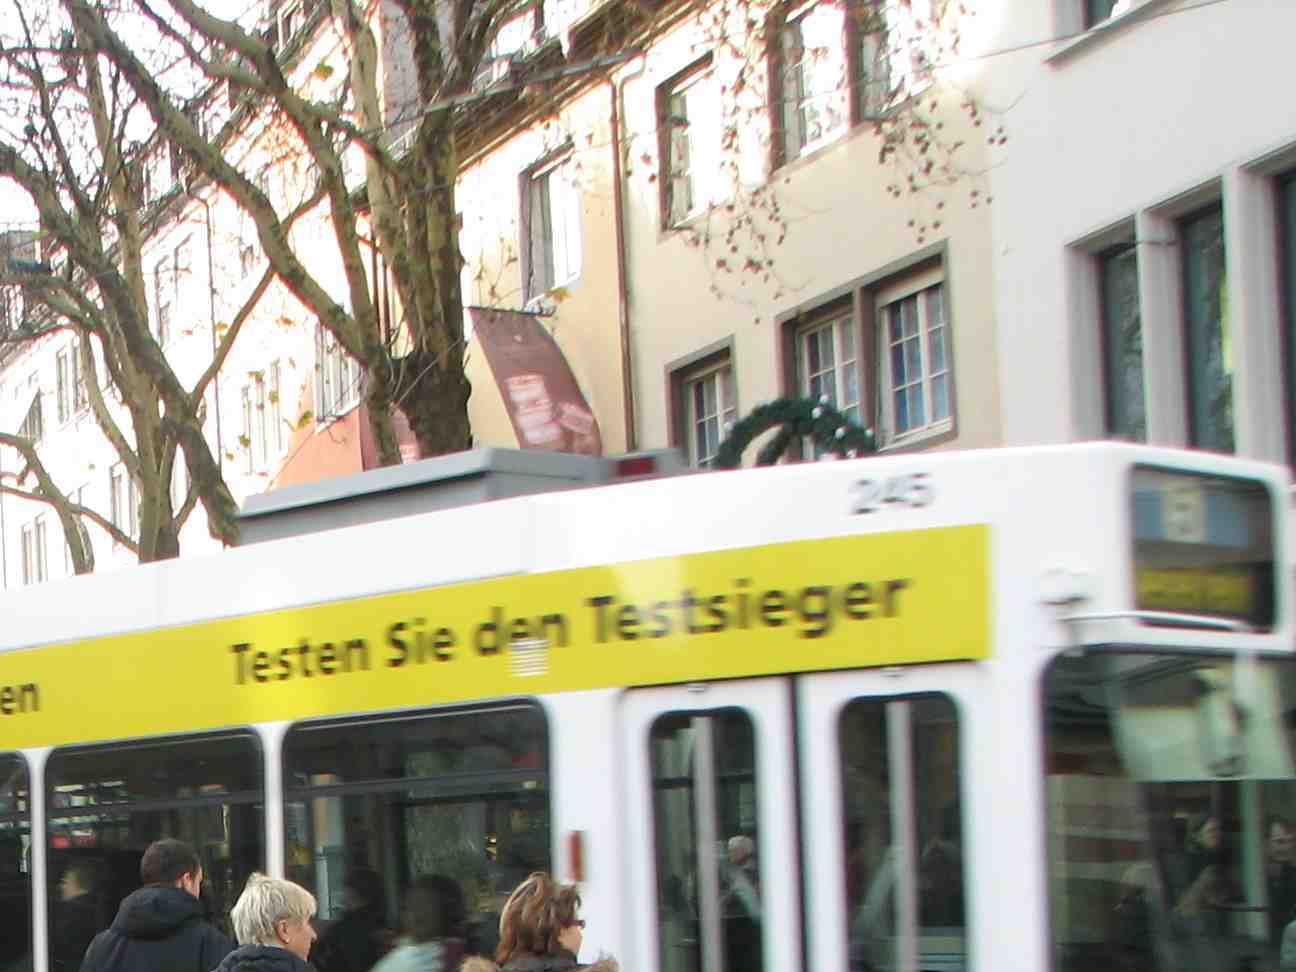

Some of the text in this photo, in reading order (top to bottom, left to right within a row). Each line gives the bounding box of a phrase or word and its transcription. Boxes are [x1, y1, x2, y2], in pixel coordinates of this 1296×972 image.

[851, 472, 933, 515] 245
[229, 577, 911, 685] Testen Sie den Testsieger
